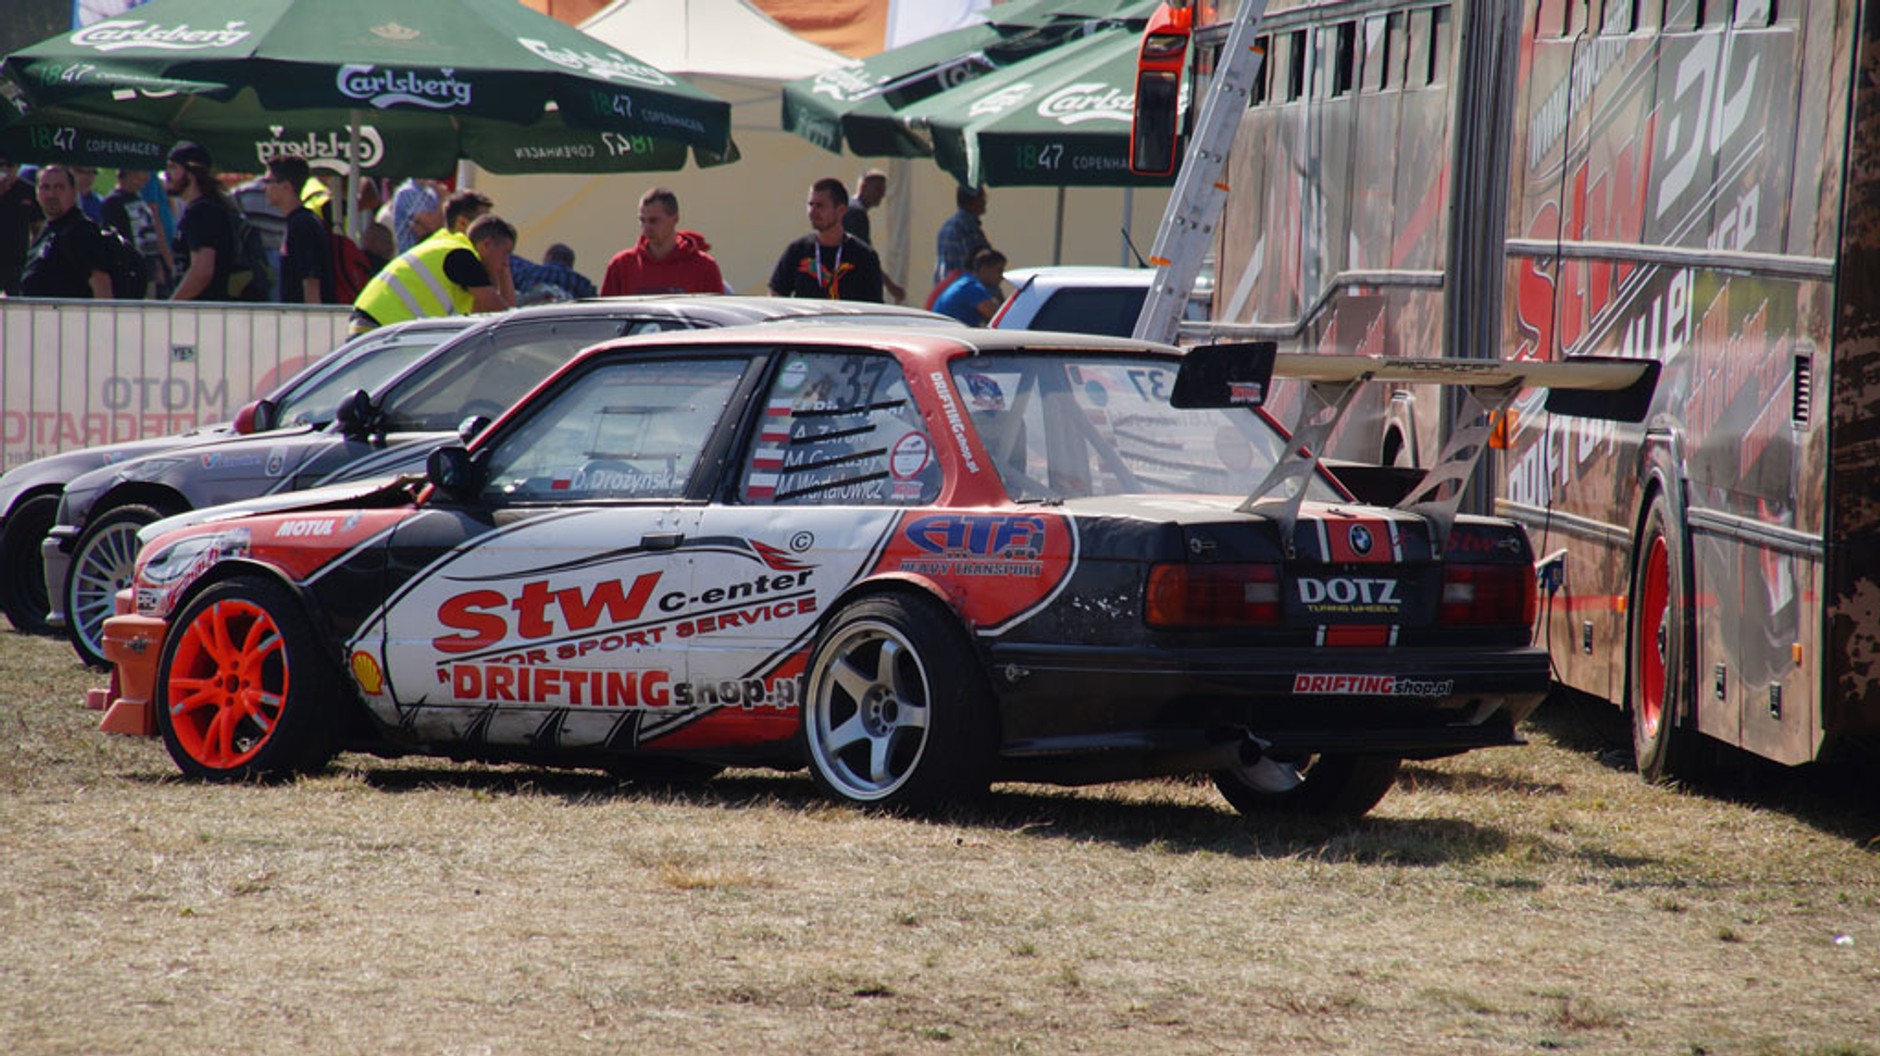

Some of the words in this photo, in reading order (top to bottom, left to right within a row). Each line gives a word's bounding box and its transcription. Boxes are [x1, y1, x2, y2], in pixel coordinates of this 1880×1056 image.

[70, 20, 250, 50] Carlsberg
[336, 63, 472, 109] Carlsberg
[86, 138, 160, 156] COPENHAGEN
[840, 357, 889, 414] 37
[276, 520, 335, 537] MOTUL
[901, 562, 950, 575] HEAVY
[955, 563, 1043, 577] TRANSPORT
[1298, 578, 1401, 604] DOTZ
[1308, 604, 1349, 612] TUNING
[1351, 604, 1399, 613] WHEELS
[556, 627, 667, 661] SPORT
[676, 597, 817, 638] SERVICE
[1294, 675, 1453, 698] DRIFTINGshop.pl
